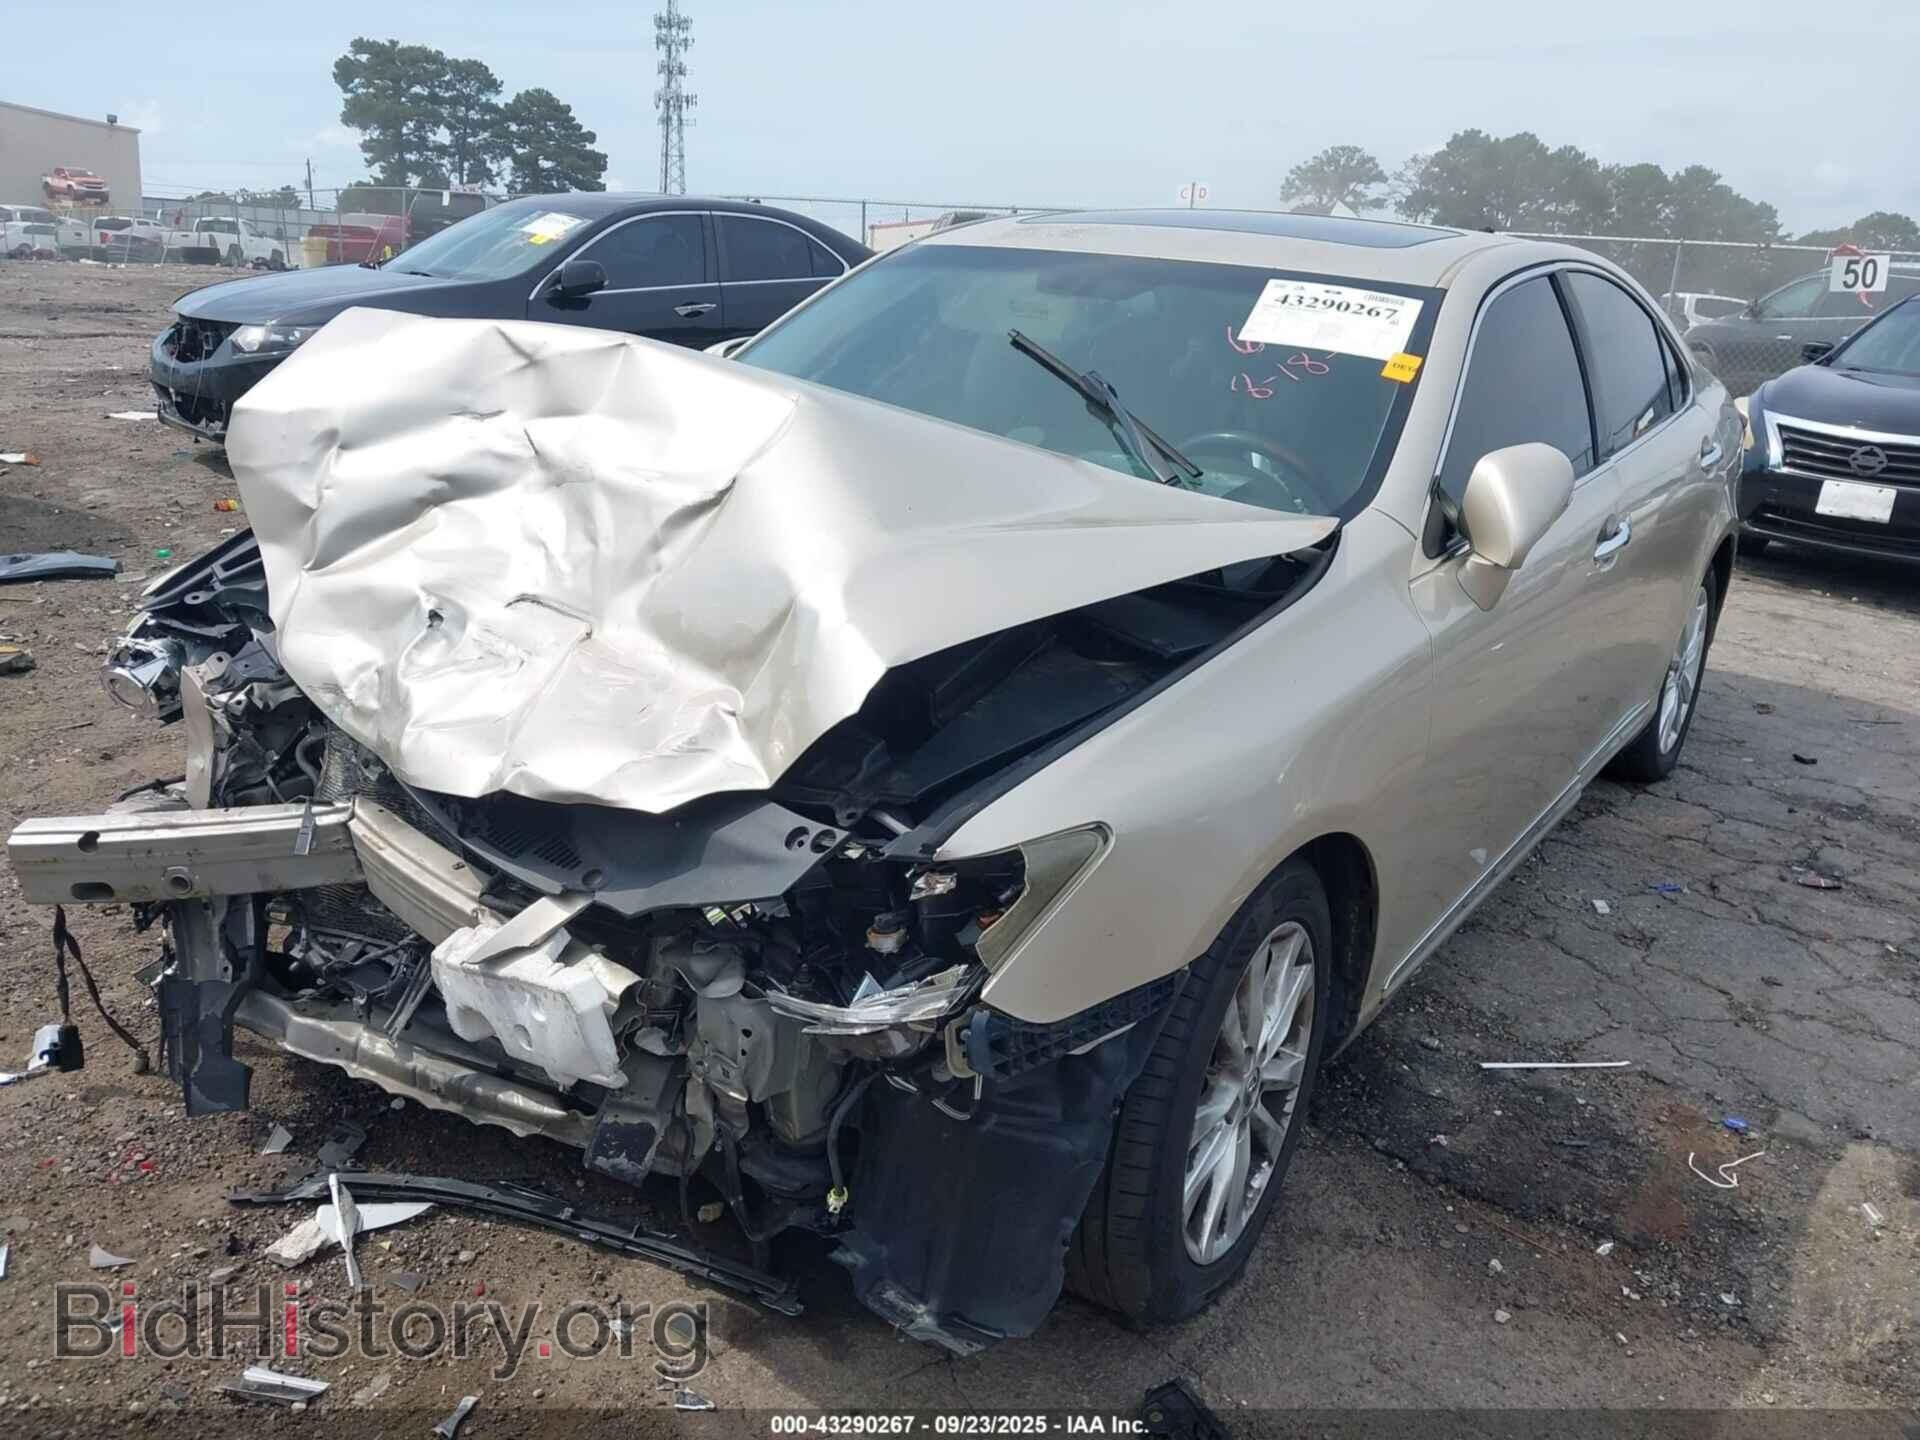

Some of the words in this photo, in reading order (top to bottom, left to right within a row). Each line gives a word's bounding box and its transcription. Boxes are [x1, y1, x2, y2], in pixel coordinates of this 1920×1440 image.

[1198, 187, 1208, 200] D
[1842, 258, 1878, 289] 50
[1275, 293, 1400, 321] 43290267
